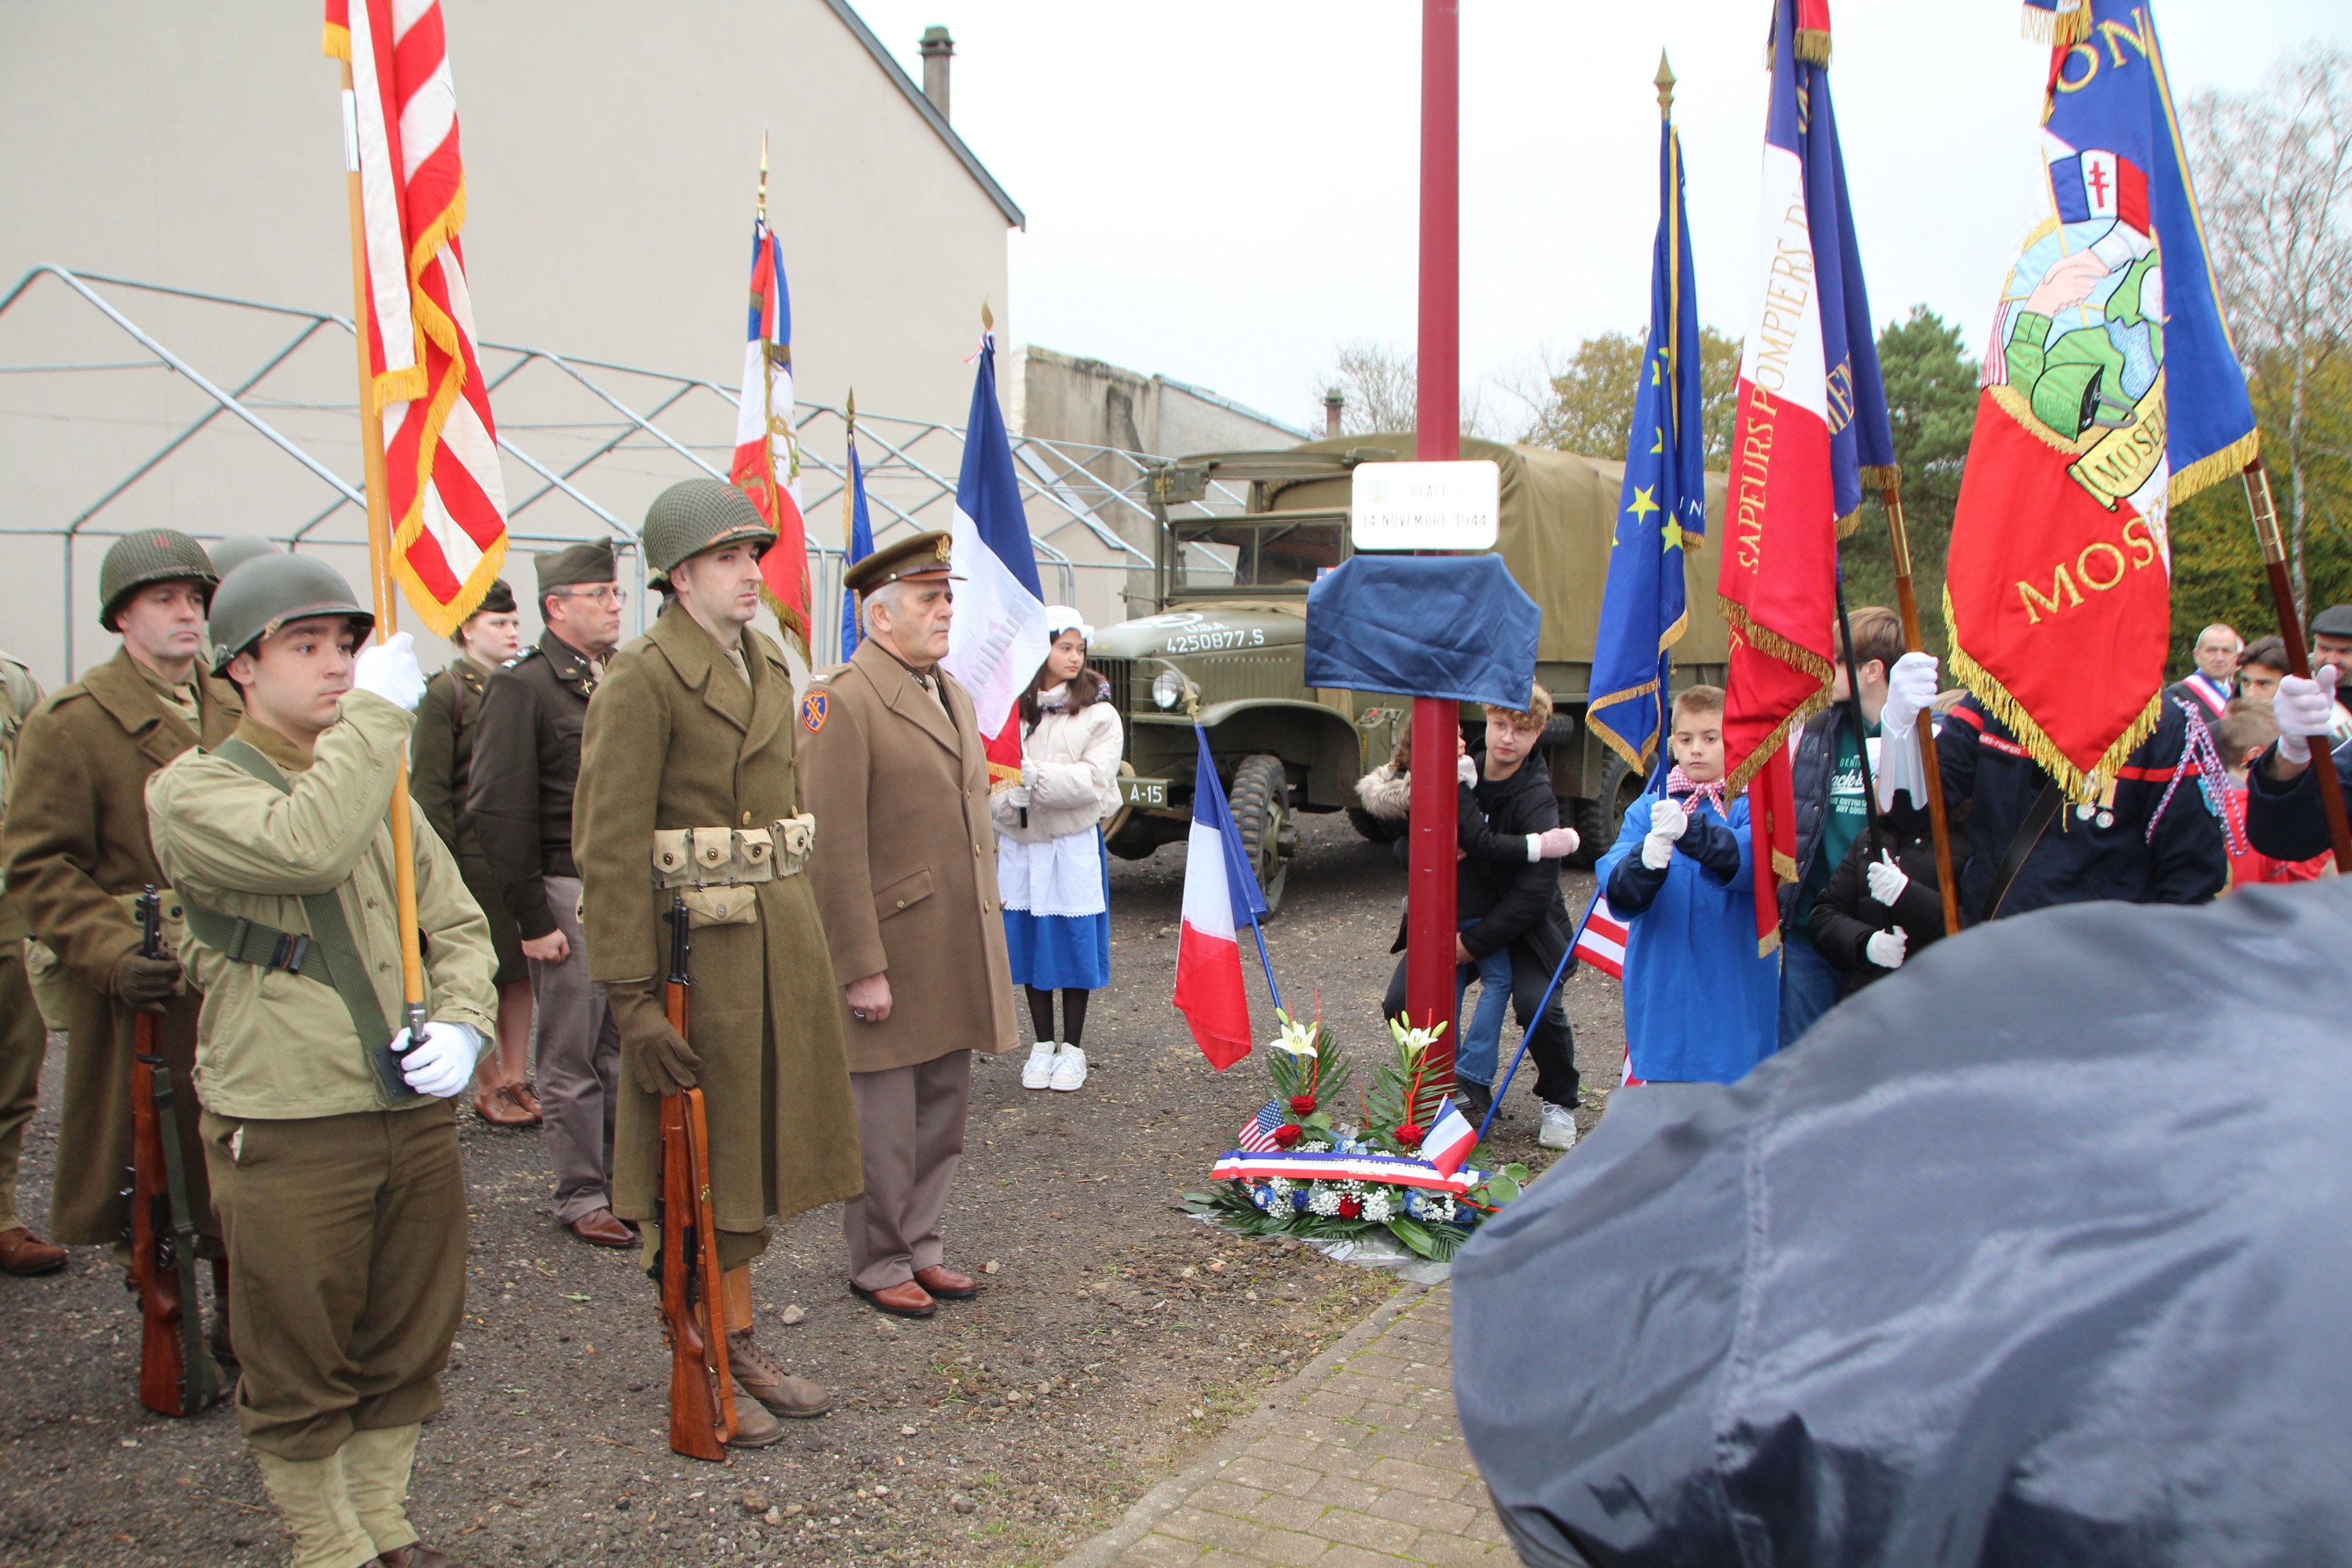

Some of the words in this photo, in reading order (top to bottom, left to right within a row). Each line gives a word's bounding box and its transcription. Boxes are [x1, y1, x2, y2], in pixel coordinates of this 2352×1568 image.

[1750, 238, 1814, 418] POMPIERS
[2095, 397, 2167, 489] MOSEL
[1363, 514, 1375, 527] 14
[1382, 514, 1446, 527] NOVEMBRE
[1456, 514, 1486, 527] 1944
[1737, 416, 1774, 574] SAPEURS
[1166, 628, 1264, 653] 4250877.S
[1130, 783, 1163, 804] A-15
